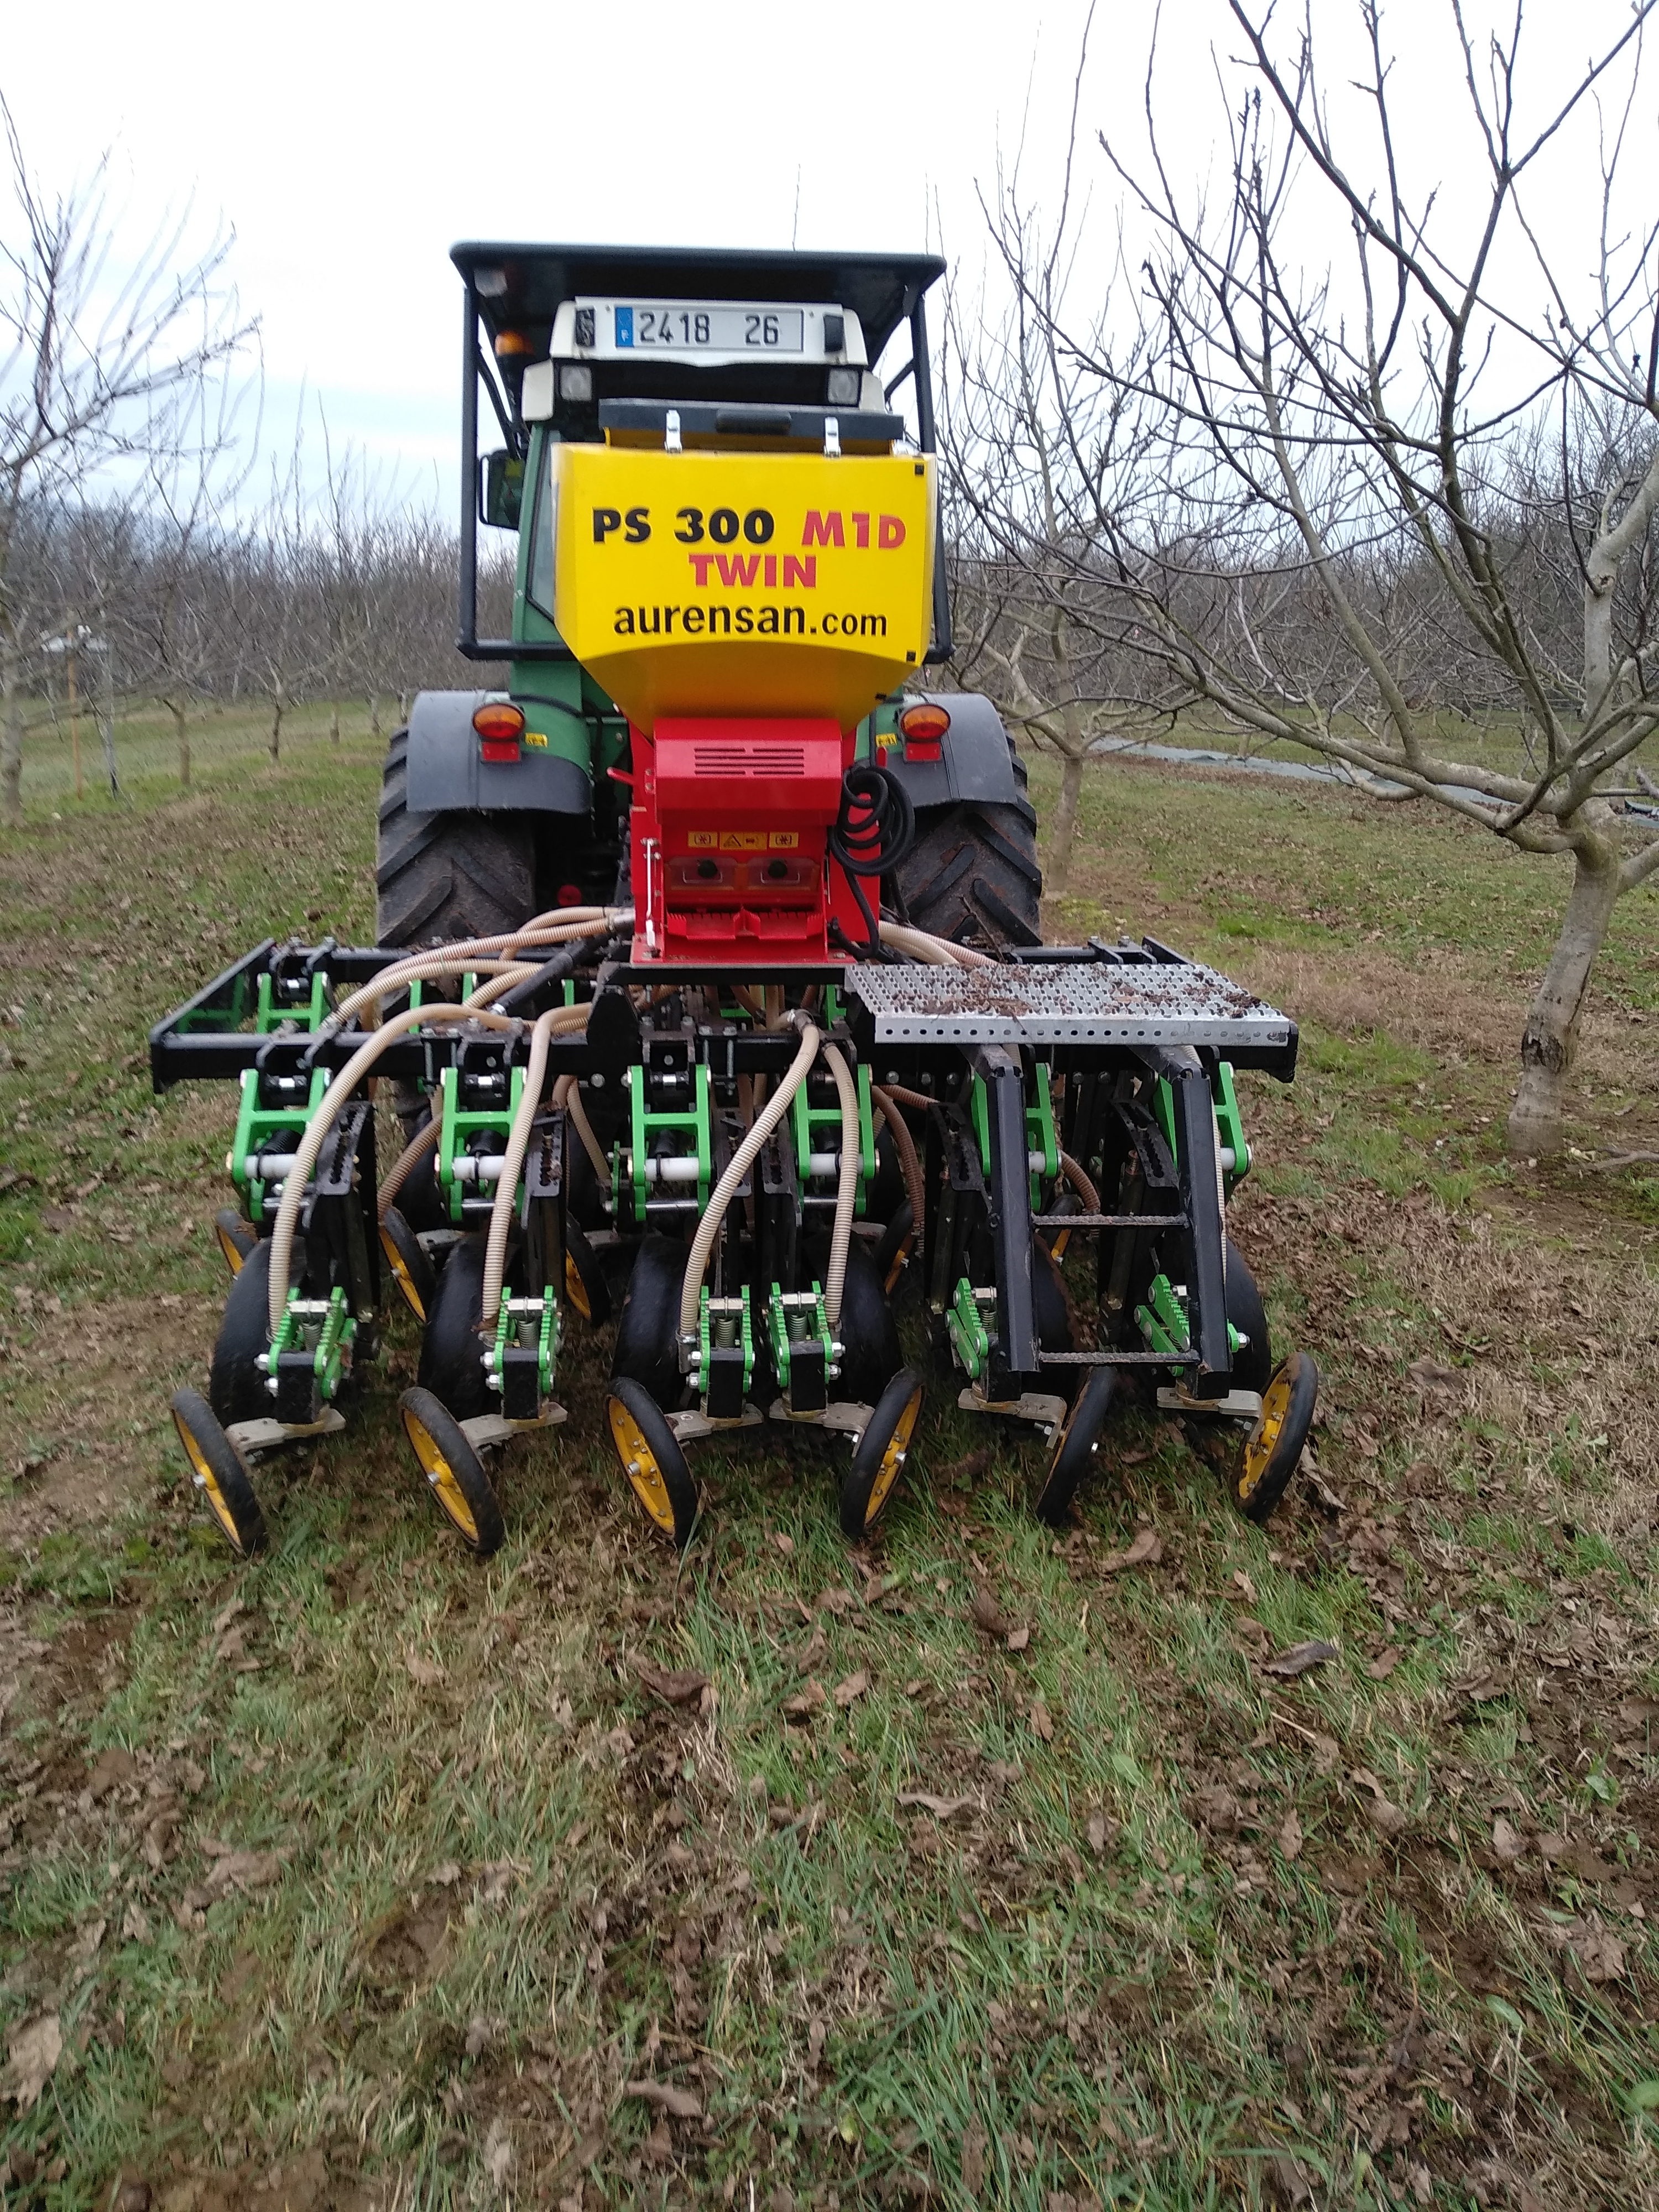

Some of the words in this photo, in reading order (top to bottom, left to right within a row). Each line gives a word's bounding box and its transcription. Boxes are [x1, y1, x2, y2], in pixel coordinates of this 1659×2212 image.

[640, 312, 710, 344] 2418
[745, 315, 779, 345] 26
[593, 508, 651, 544] PS
[675, 508, 775, 544] 300
[801, 510, 907, 550] M1D
[688, 553, 817, 589] TWIN
[614, 606, 887, 637] aurensan.com
